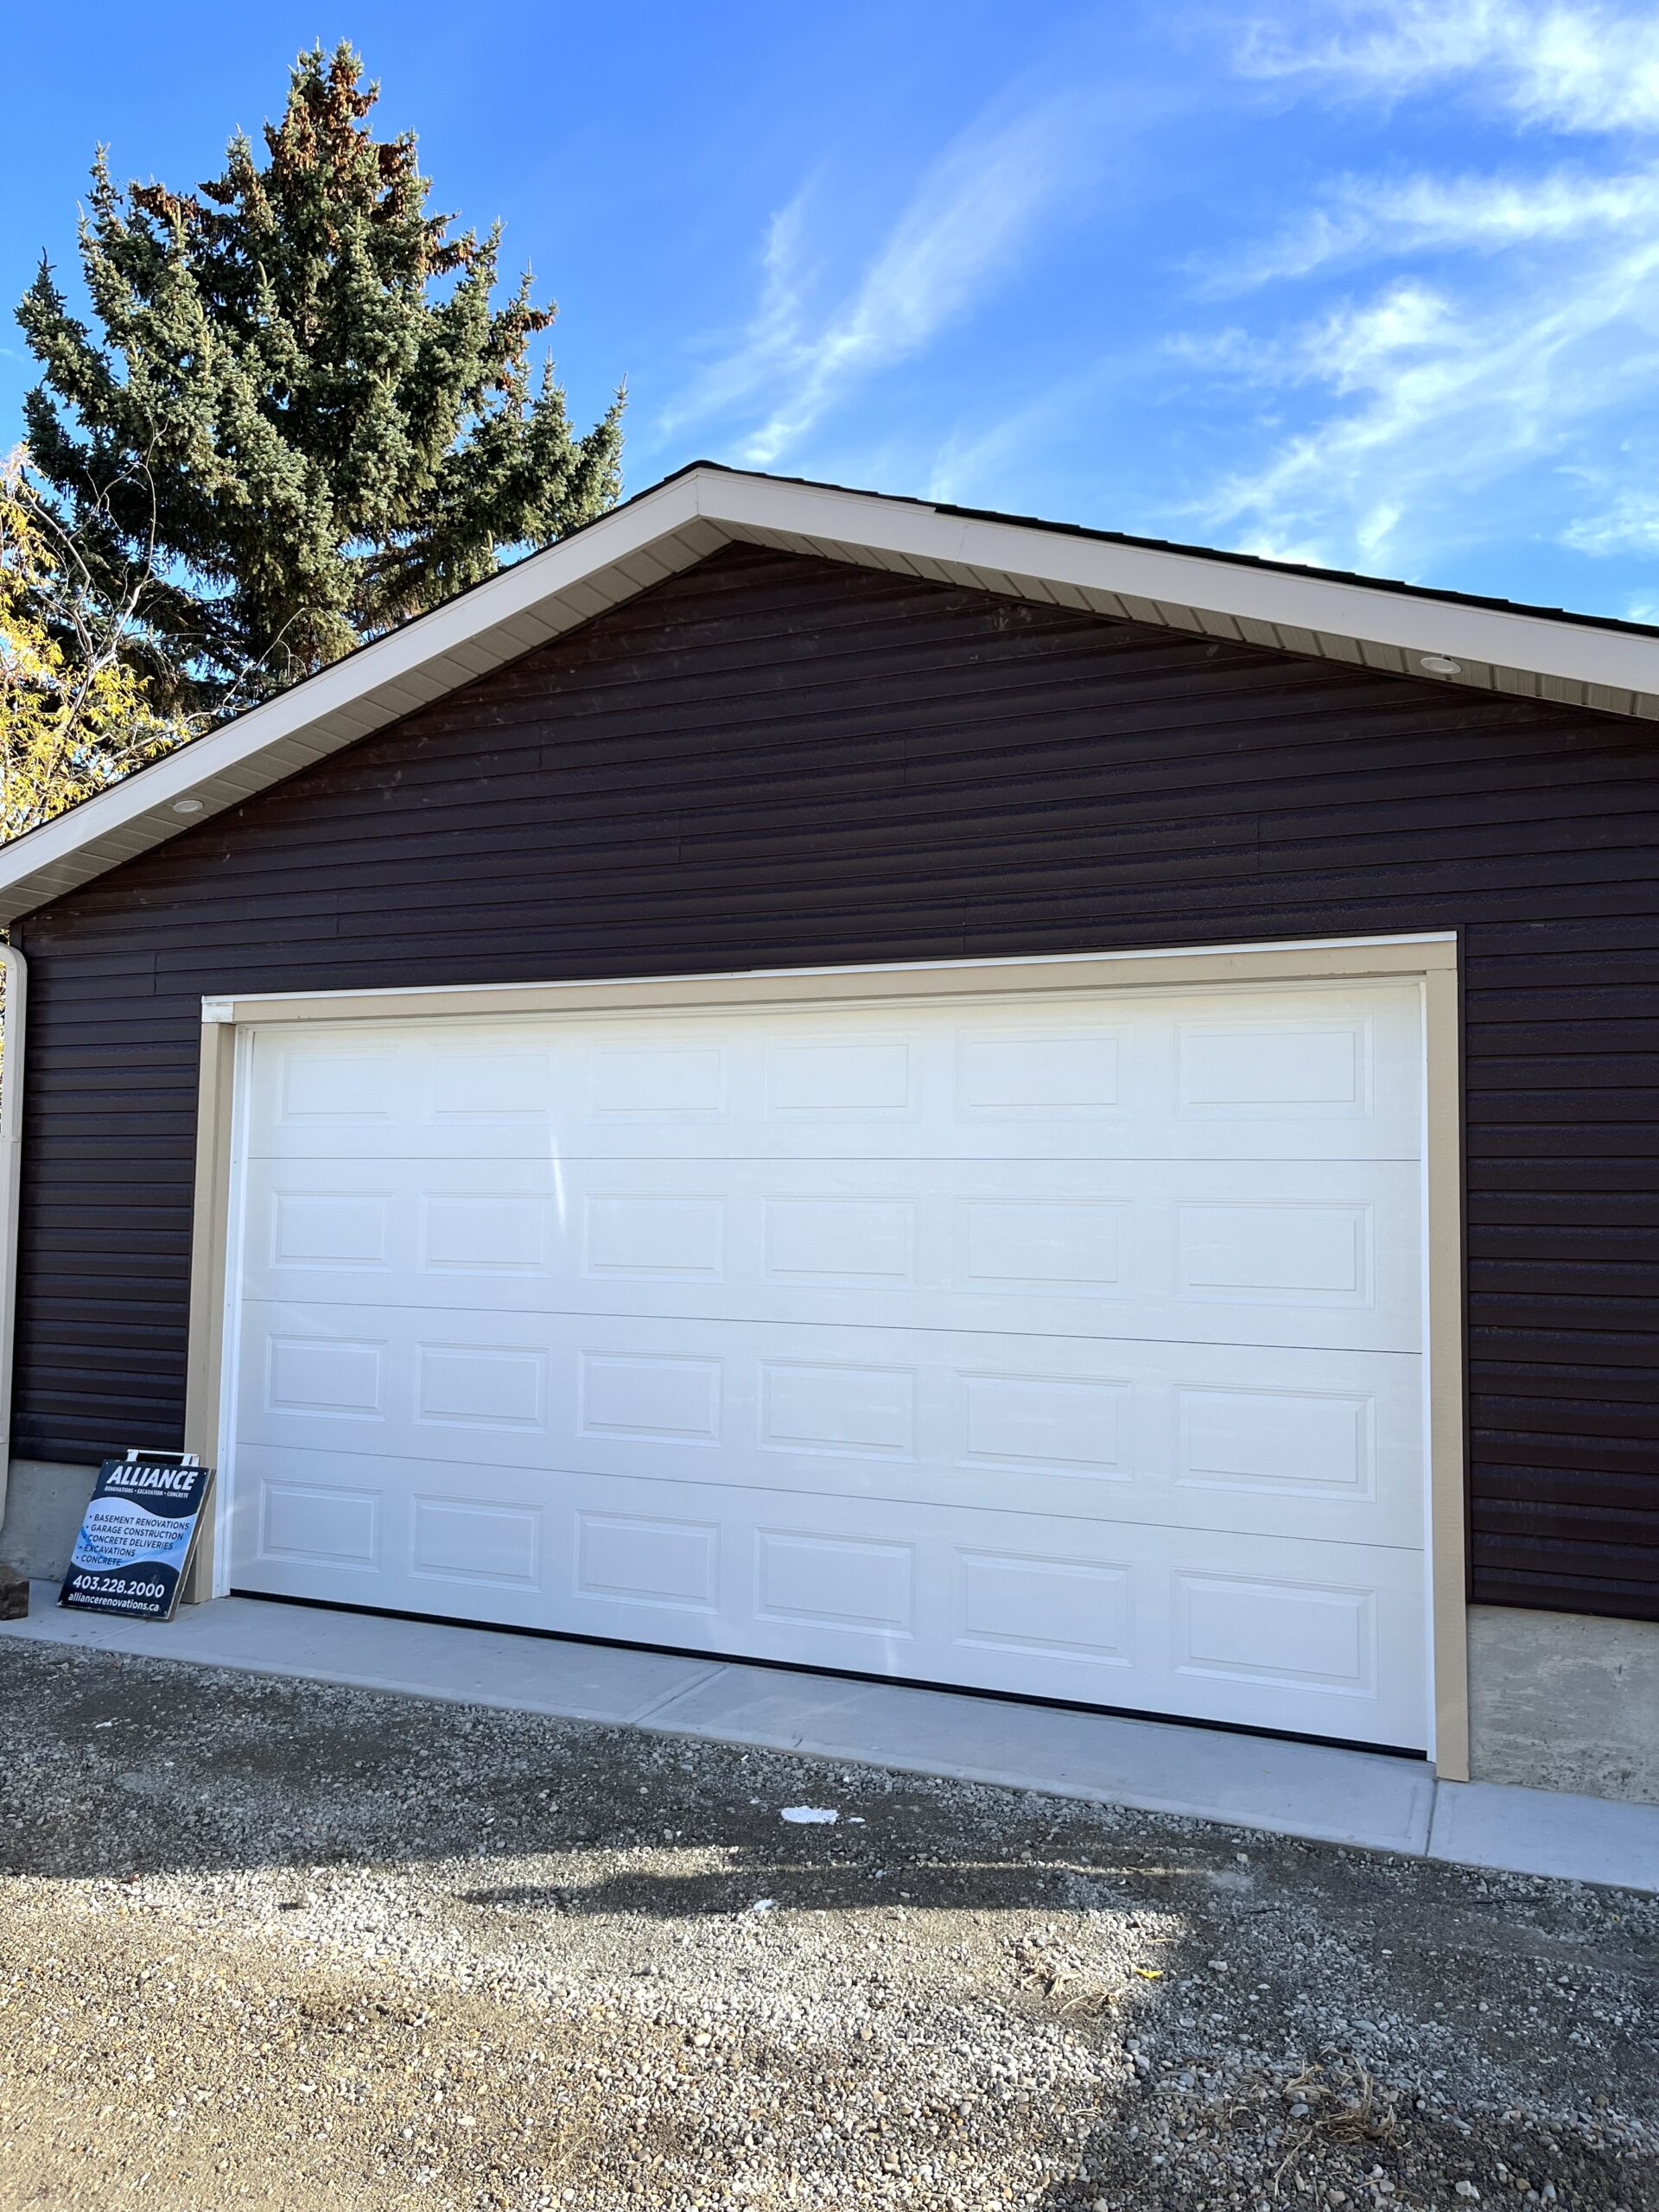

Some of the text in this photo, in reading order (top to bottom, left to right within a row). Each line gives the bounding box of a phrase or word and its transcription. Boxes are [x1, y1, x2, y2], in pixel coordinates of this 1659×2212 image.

[106, 1465, 199, 1491] ALLIANCE
[94, 1514, 189, 1530] BASEMENT RENOVATIONS
[91, 1524, 183, 1541] GARAGE CONSTRUCTION
[87, 1535, 173, 1549] CONCRETE DELIVERIES
[84, 1545, 136, 1556] EXCAVATIONS
[81, 1556, 121, 1566] CONCRETE
[73, 1575, 165, 1598] 403.228.2000
[68, 1592, 159, 1611] alliancerenovations.ca
